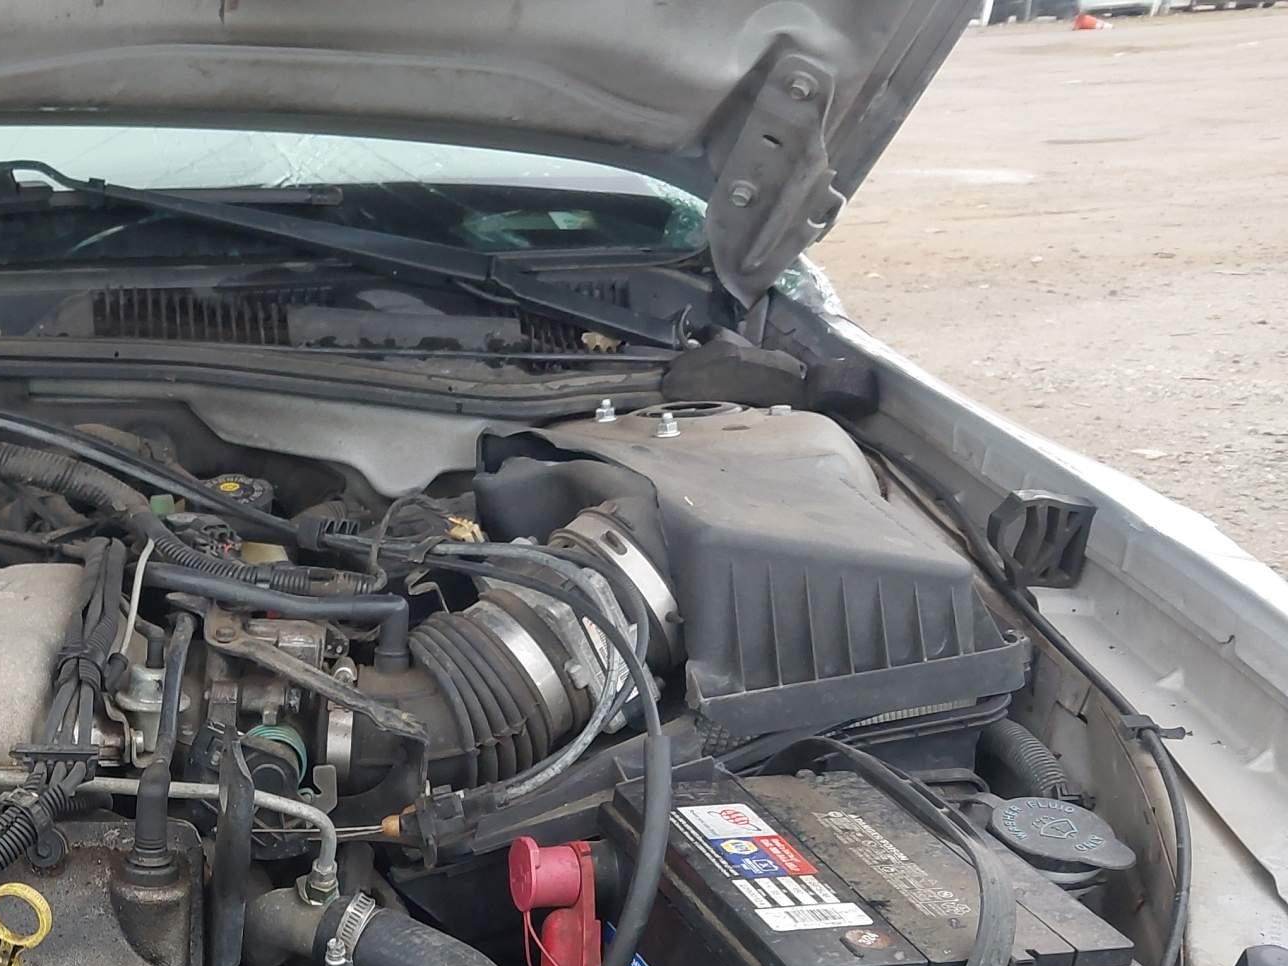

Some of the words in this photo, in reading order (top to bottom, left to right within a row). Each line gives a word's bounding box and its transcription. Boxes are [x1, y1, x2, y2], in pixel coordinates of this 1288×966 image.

[1002, 804, 1028, 841] WASHER
[1026, 799, 1075, 814] FLUID
[1074, 833, 1105, 852] ONLY
